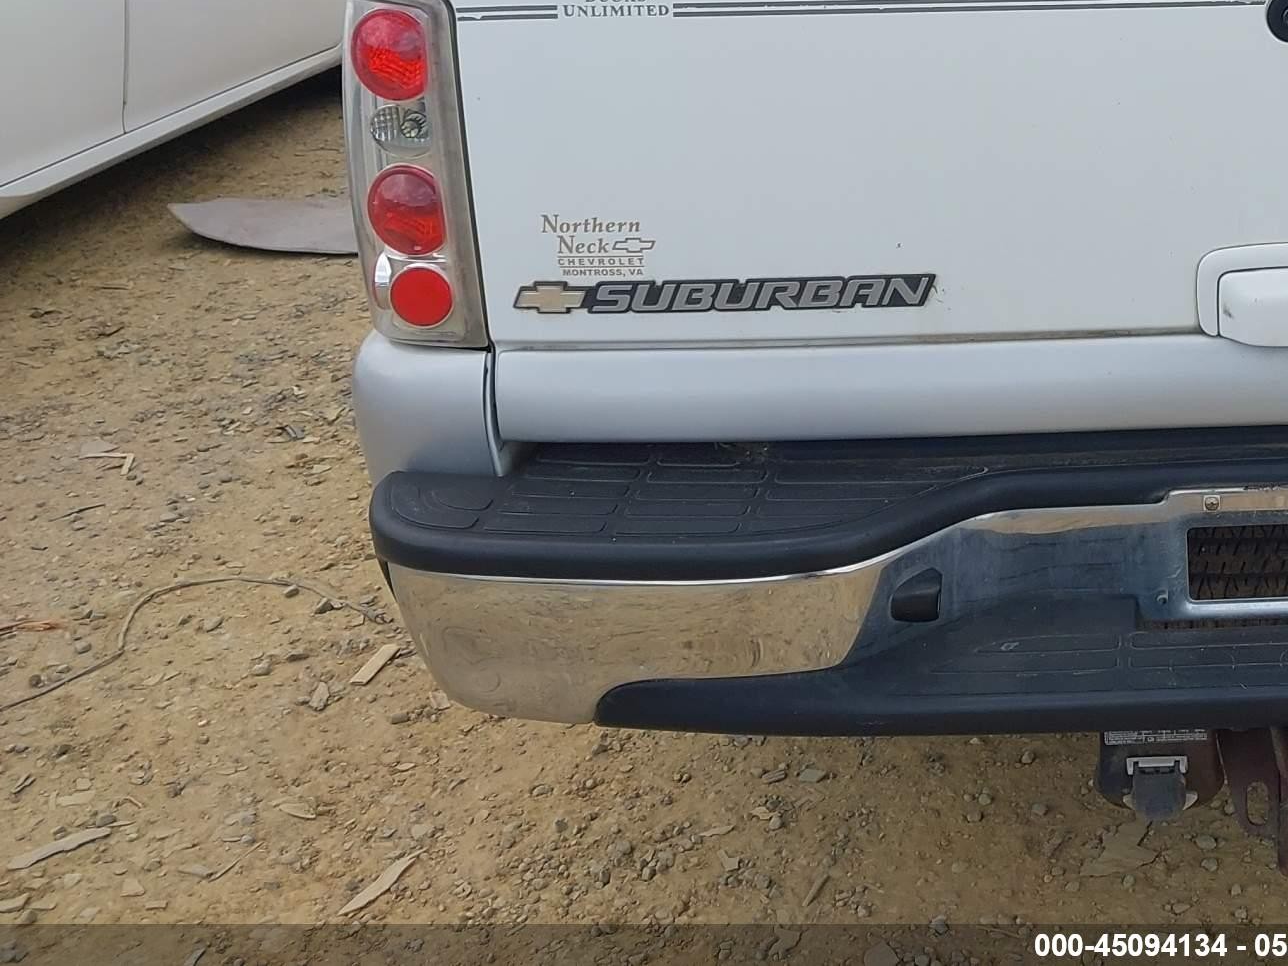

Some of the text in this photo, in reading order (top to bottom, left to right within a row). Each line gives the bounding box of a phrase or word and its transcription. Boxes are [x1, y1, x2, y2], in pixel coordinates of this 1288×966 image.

[563, 5, 669, 17] UNLIMITED
[541, 214, 640, 233] Northern
[557, 235, 609, 254] Neck
[558, 257, 644, 265] CHEVROLET
[562, 269, 626, 277] MONTROSS,
[589, 275, 932, 313] SUBURBAN
